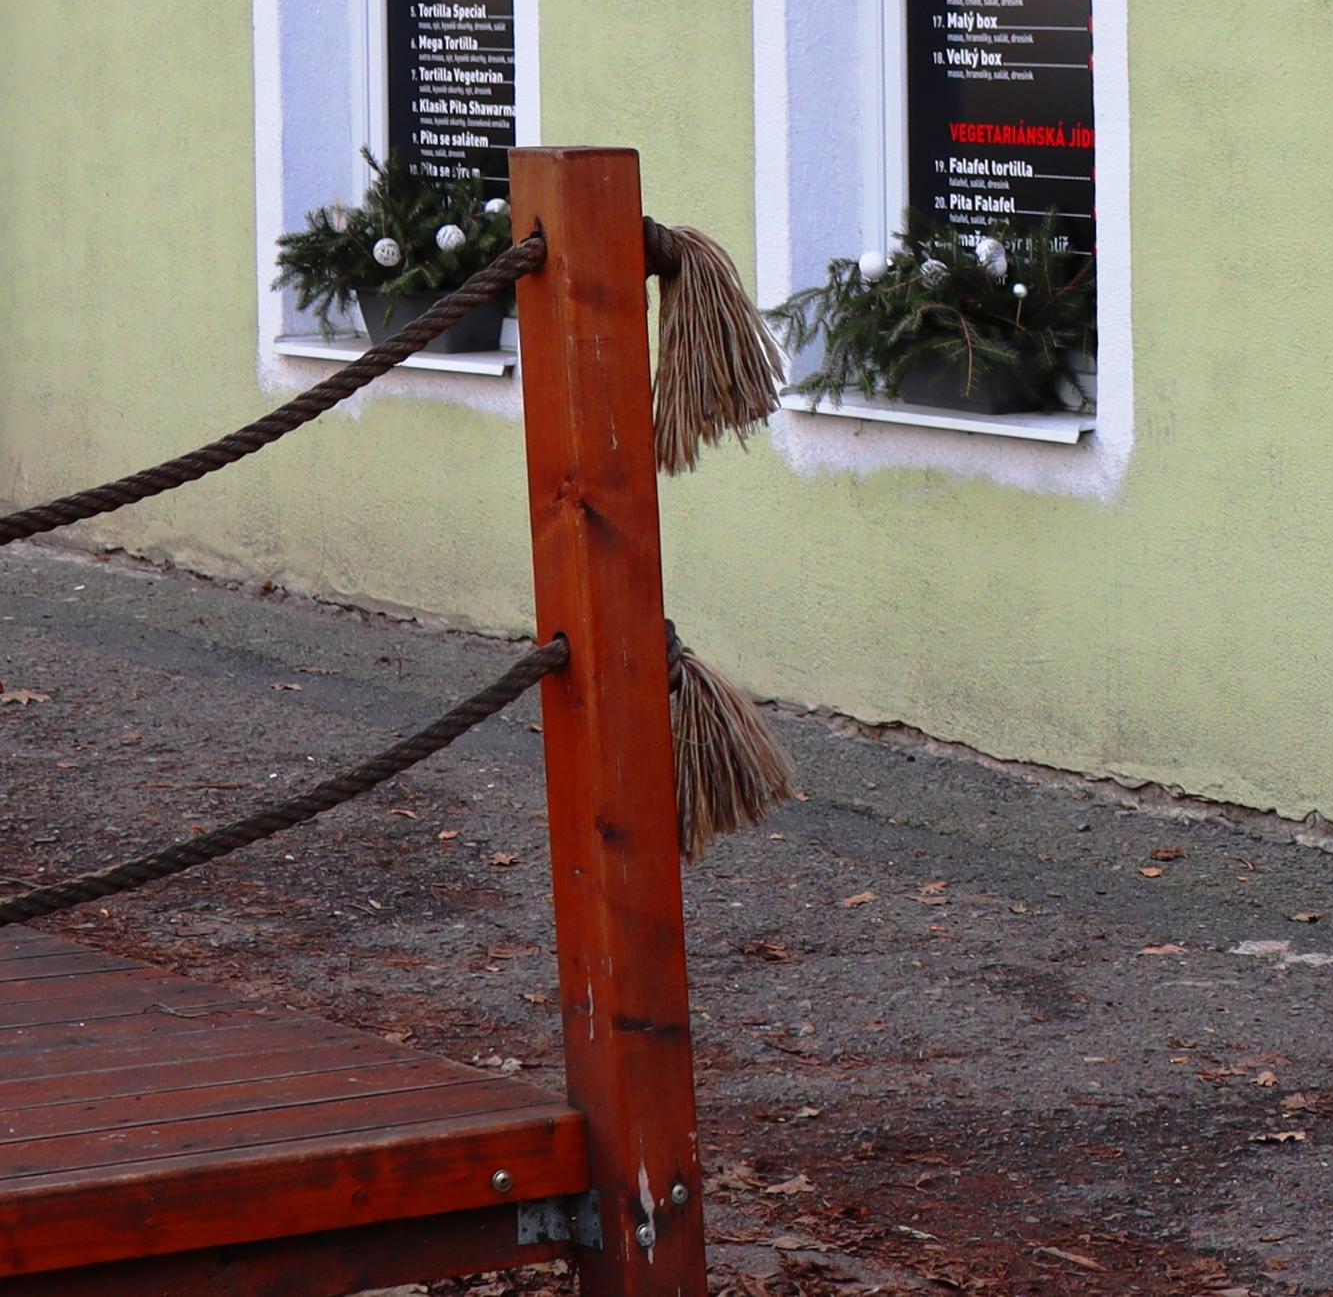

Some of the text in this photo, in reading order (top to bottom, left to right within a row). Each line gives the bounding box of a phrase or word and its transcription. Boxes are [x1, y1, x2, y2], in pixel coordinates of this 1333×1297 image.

[418, 3, 486, 21] Tortilla Special
[933, 10, 998, 32] 17. Malý box
[418, 35, 478, 52] Mega Tortilla
[946, 47, 1002, 69] Velký box
[419, 66, 503, 85] Tortilla Vegetarian
[419, 98, 468, 115] Klasik Pita
[420, 130, 489, 148] Pita se salátem
[949, 119, 1065, 147] VEGETARIÁNSKÁ
[934, 157, 1033, 178] 19. Falafel tortilla
[950, 193, 1015, 213] Pita Falafel
